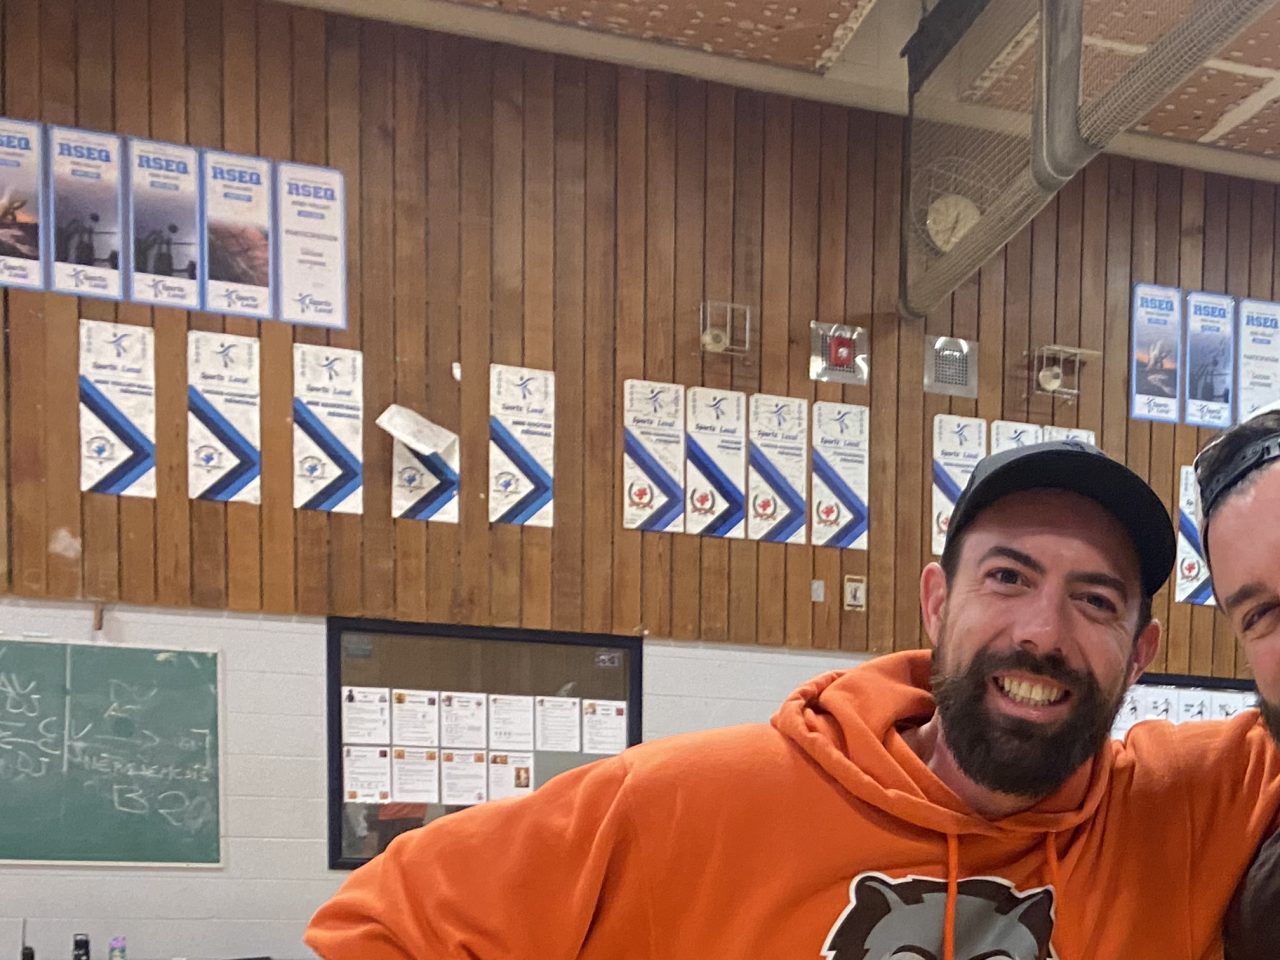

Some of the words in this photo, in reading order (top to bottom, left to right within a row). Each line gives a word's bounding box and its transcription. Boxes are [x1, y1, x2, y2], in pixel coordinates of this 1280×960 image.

[58, 143, 112, 162] RSEQ
[138, 154, 189, 175] RSEQ
[212, 166, 262, 185] RSEQ
[286, 182, 336, 202] RSEQ
[1139, 296, 1175, 312] RSEQ
[1193, 304, 1227, 319] RSEQ
[1246, 314, 1279, 329] RSEQ
[632, 416, 653, 427] Sports
[695, 423, 715, 433] Sports
[757, 429, 776, 439] Sports
[820, 437, 840, 447] Sports
